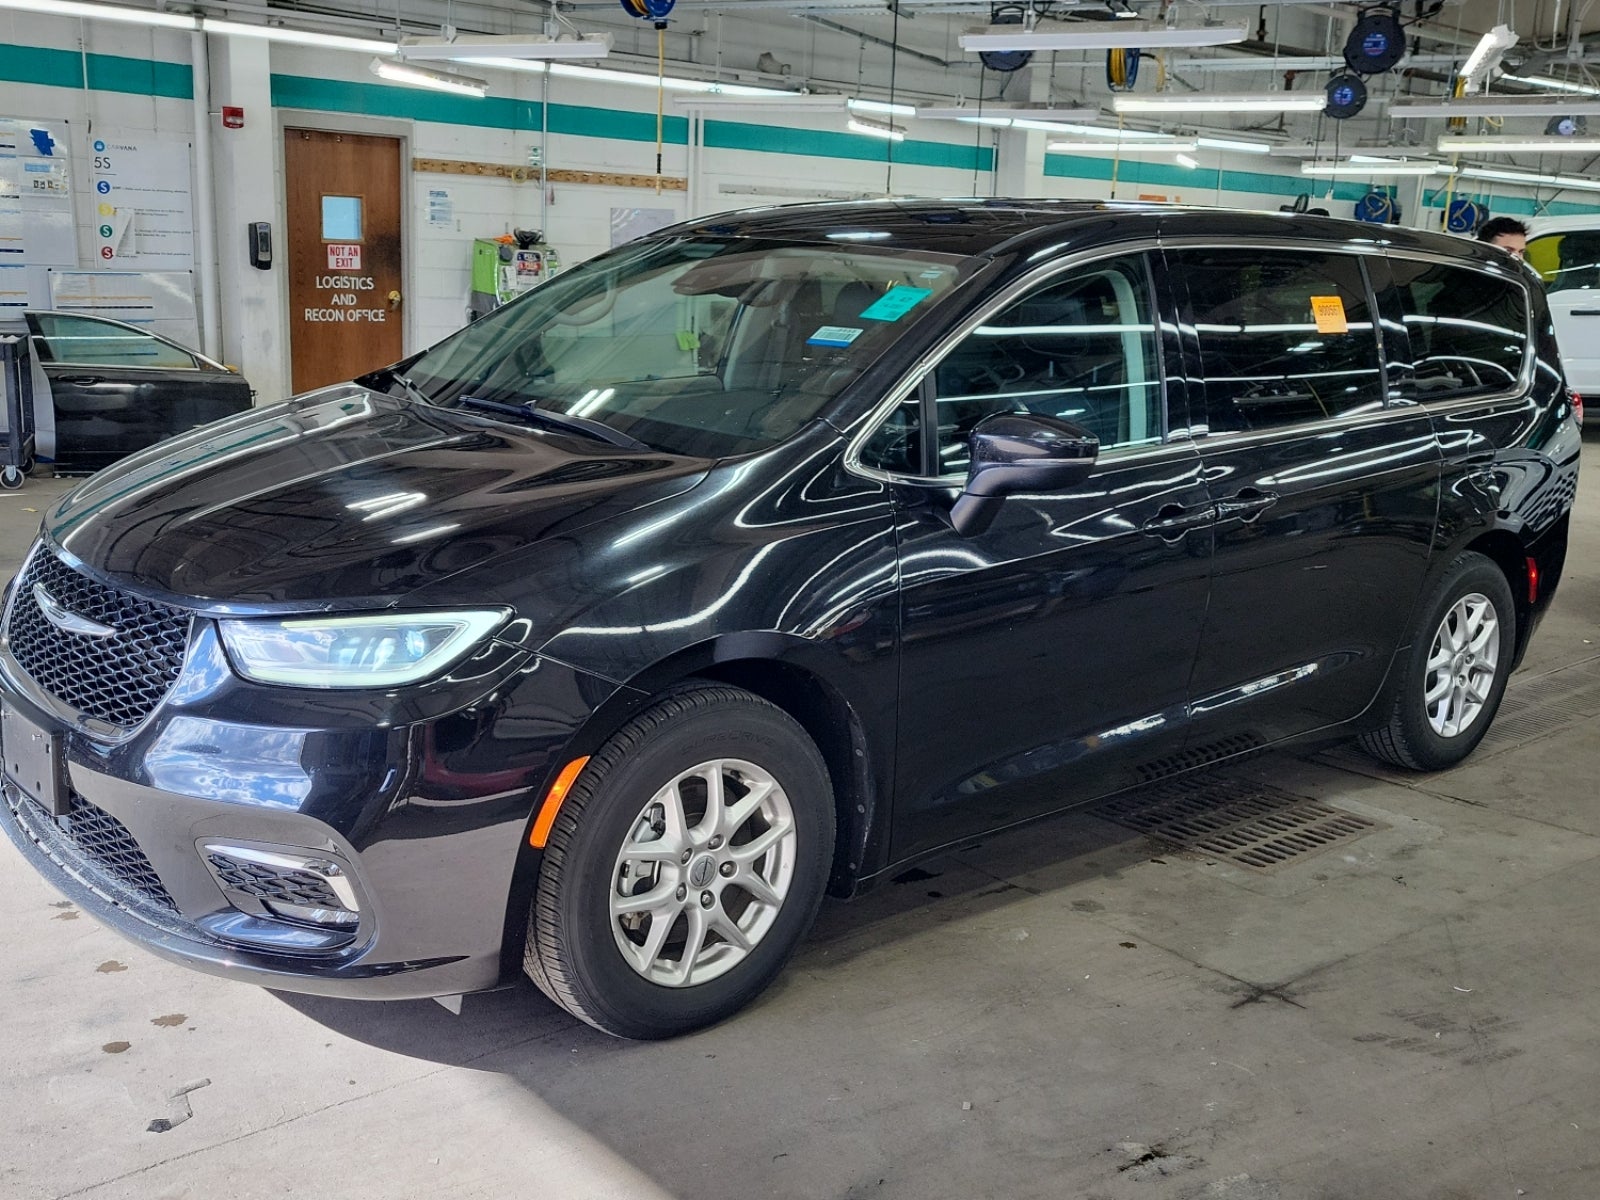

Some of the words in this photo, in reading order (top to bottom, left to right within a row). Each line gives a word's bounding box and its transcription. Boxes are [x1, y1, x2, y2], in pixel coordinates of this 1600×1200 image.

[94, 157, 111, 169] 5S
[99, 182, 107, 193] S
[103, 226, 110, 237] S
[104, 247, 111, 258] S
[329, 246, 345, 256] NOT
[348, 247, 358, 256] AN
[335, 257, 353, 267] EXIT
[316, 276, 374, 290] LOGISTICS
[331, 293, 357, 305] AND
[304, 308, 345, 322] RECON
